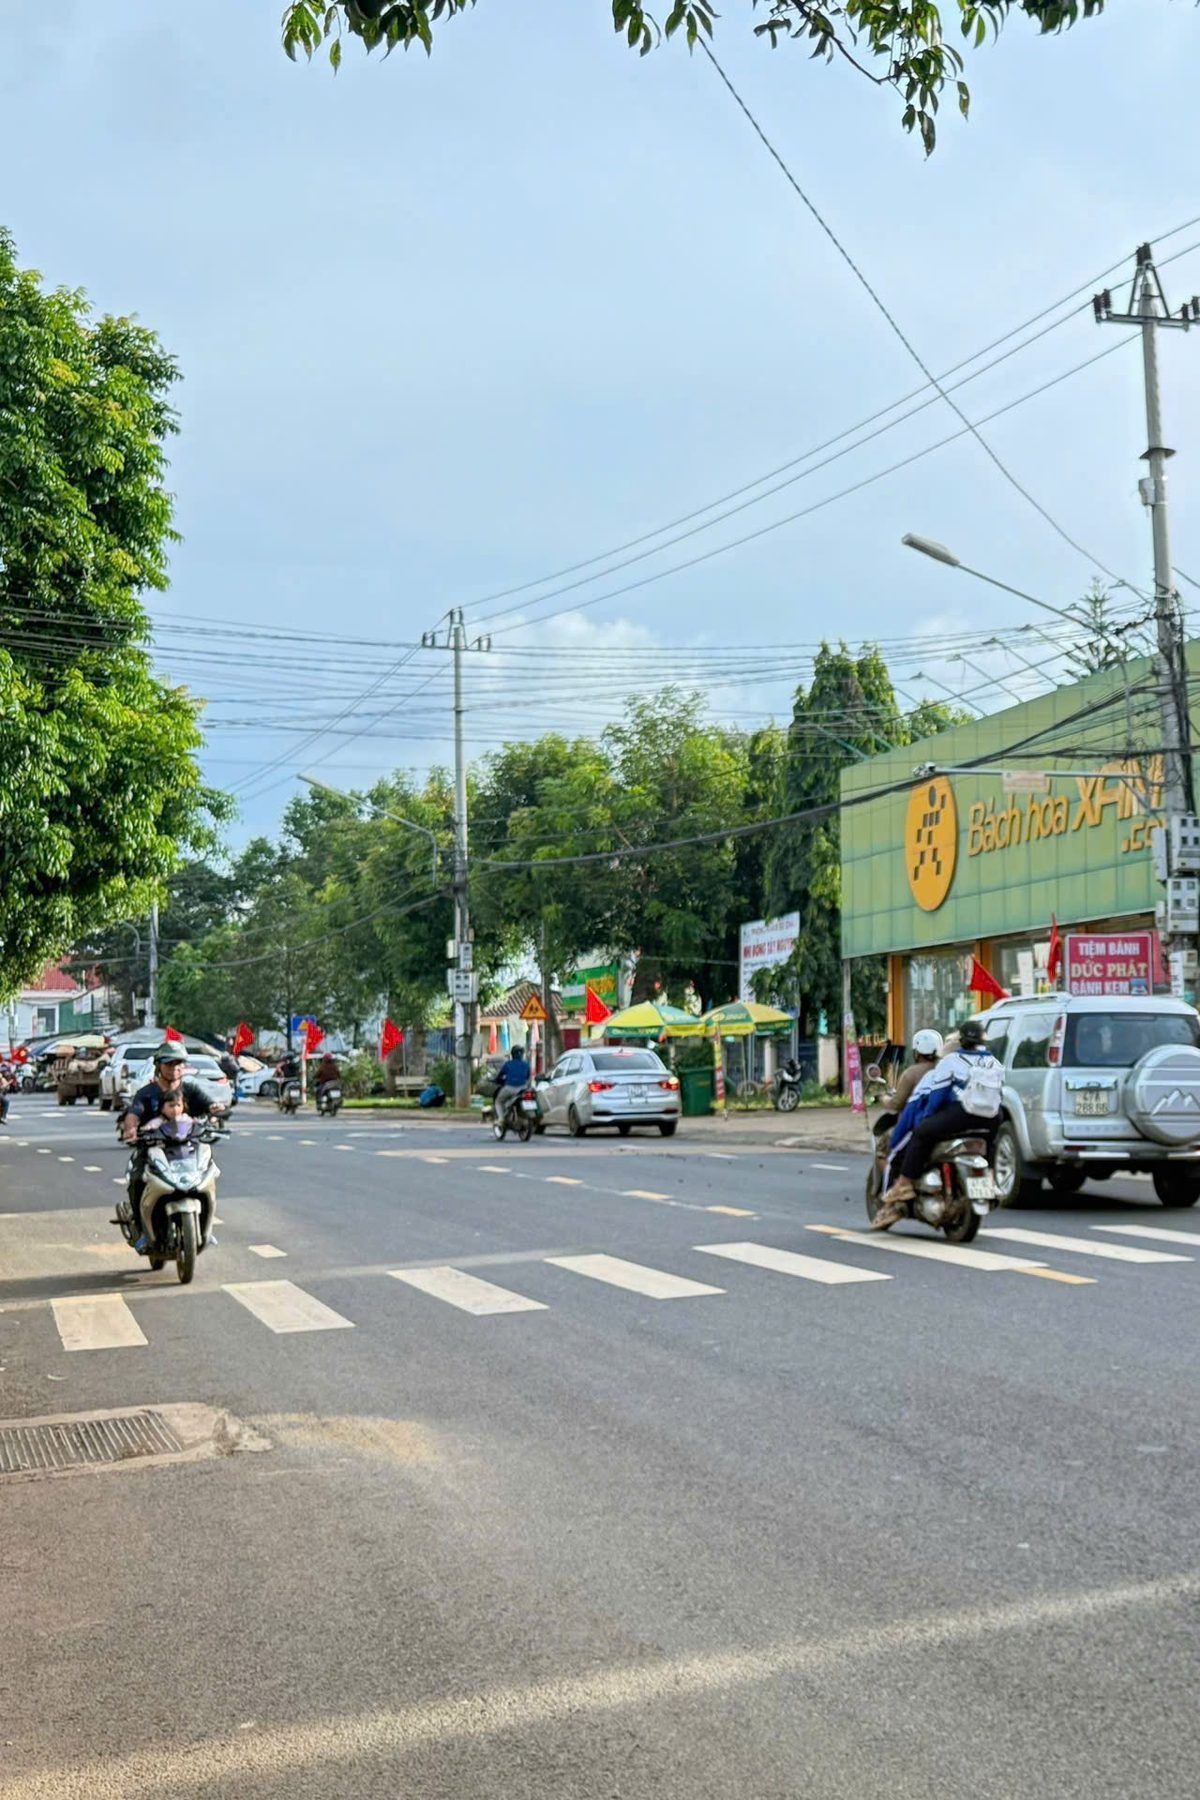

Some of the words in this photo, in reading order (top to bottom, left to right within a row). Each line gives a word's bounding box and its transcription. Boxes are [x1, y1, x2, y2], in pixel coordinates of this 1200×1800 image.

[967, 793, 1022, 858] Bách
[1108, 940, 1140, 956] BÁNH
[1071, 959, 1104, 978] ĐỨC
[1106, 960, 1148, 978] PHÁT
[1104, 981, 1130, 995] KEM
